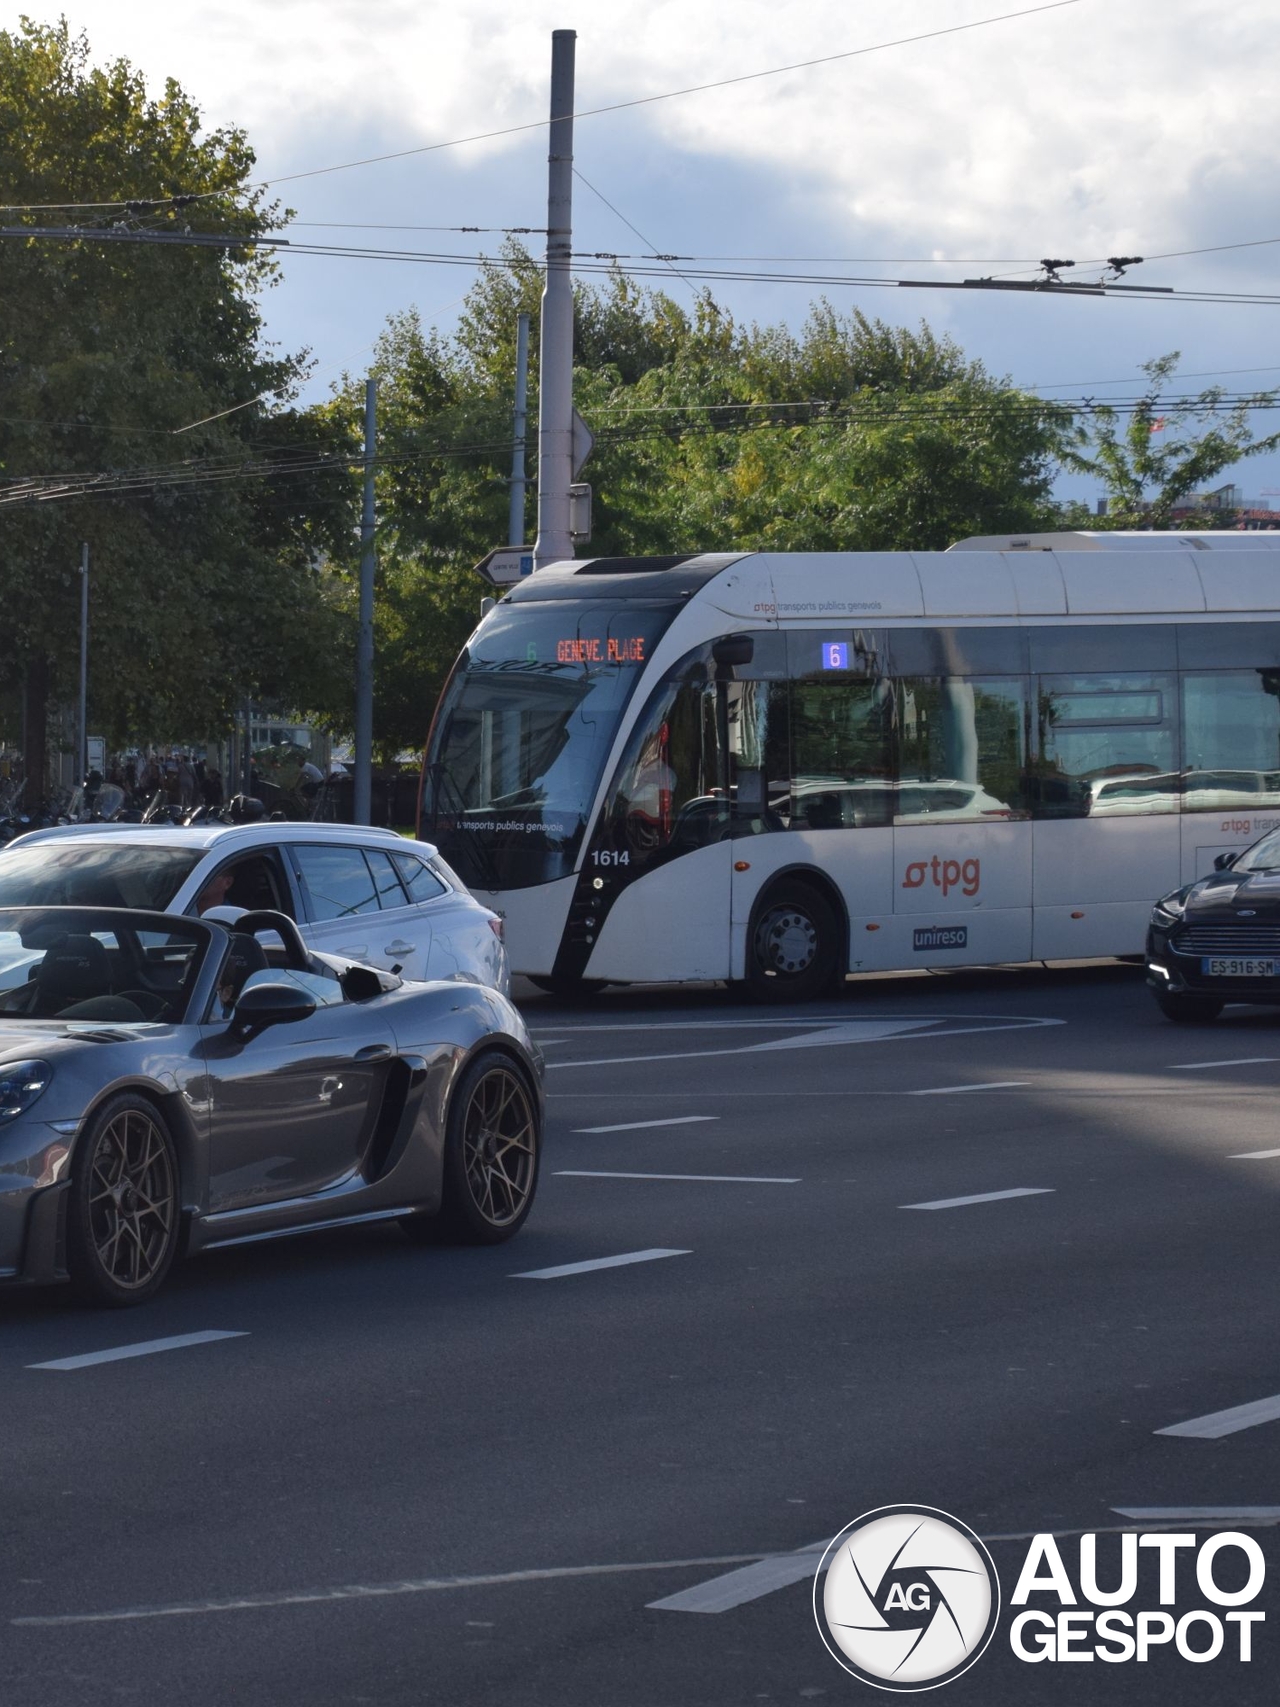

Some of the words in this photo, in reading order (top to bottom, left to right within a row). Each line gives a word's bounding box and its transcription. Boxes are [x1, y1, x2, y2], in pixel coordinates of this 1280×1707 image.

[777, 602, 817, 613] transports
[818, 601, 847, 612] publics
[608, 638, 645, 661] PLAGE
[830, 644, 841, 667] 6
[496, 821, 524, 832] publics
[526, 822, 563, 833] genevois
[591, 850, 630, 866] 1614
[914, 926, 966, 946] unireso
[1211, 961, 1273, 974] ES-916-SM
